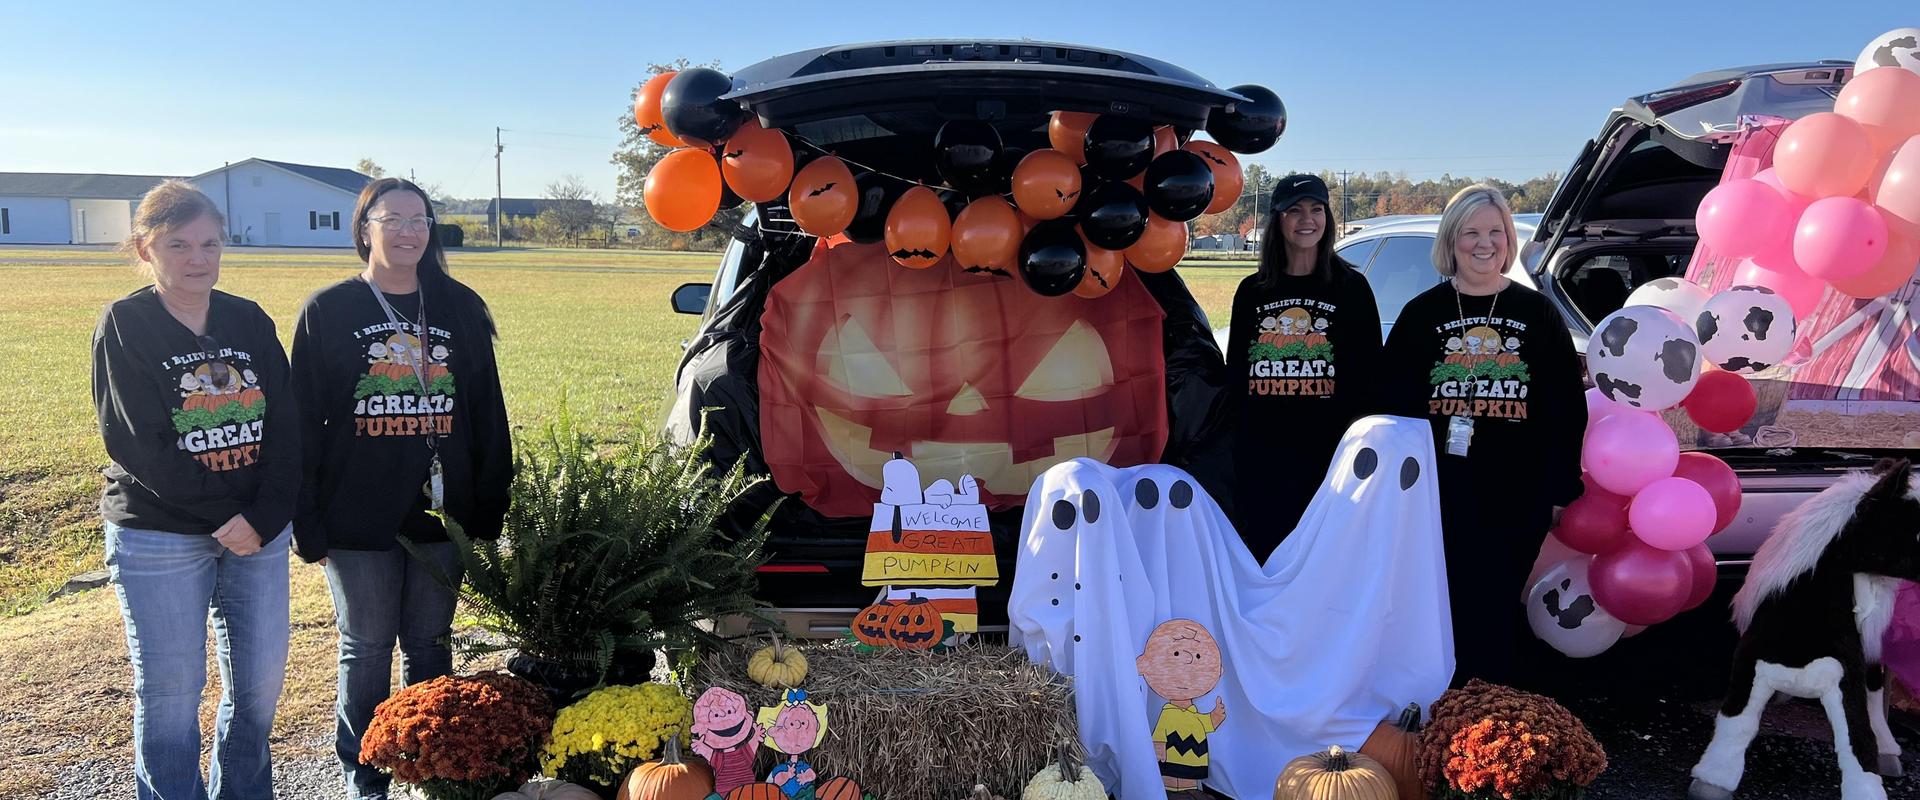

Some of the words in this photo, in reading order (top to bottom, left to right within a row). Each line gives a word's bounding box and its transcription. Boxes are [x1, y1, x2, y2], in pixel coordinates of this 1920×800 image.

[1264, 299, 1302, 311] BELIEVE
[1317, 301, 1336, 312] THE
[353, 331, 361, 339] I
[362, 322, 409, 335] BELIEE
[428, 326, 451, 339] THE
[1444, 317, 1487, 330] BELIEVE
[1490, 317, 1503, 325] IN
[1506, 319, 1526, 331] THE
[162, 361, 171, 370] I
[172, 352, 214, 365] BLIEV
[219, 347, 233, 359] IN
[233, 351, 251, 362] HE
[1254, 360, 1326, 377] GREAT
[1248, 379, 1335, 396] PUMPKIN
[367, 394, 445, 415] GREAT
[355, 415, 453, 437] PUMPKIN
[185, 419, 263, 452] GREAT
[904, 510, 982, 529] WELCOME
[902, 533, 985, 550] GREAT
[883, 556, 980, 575] PUMPKIN
